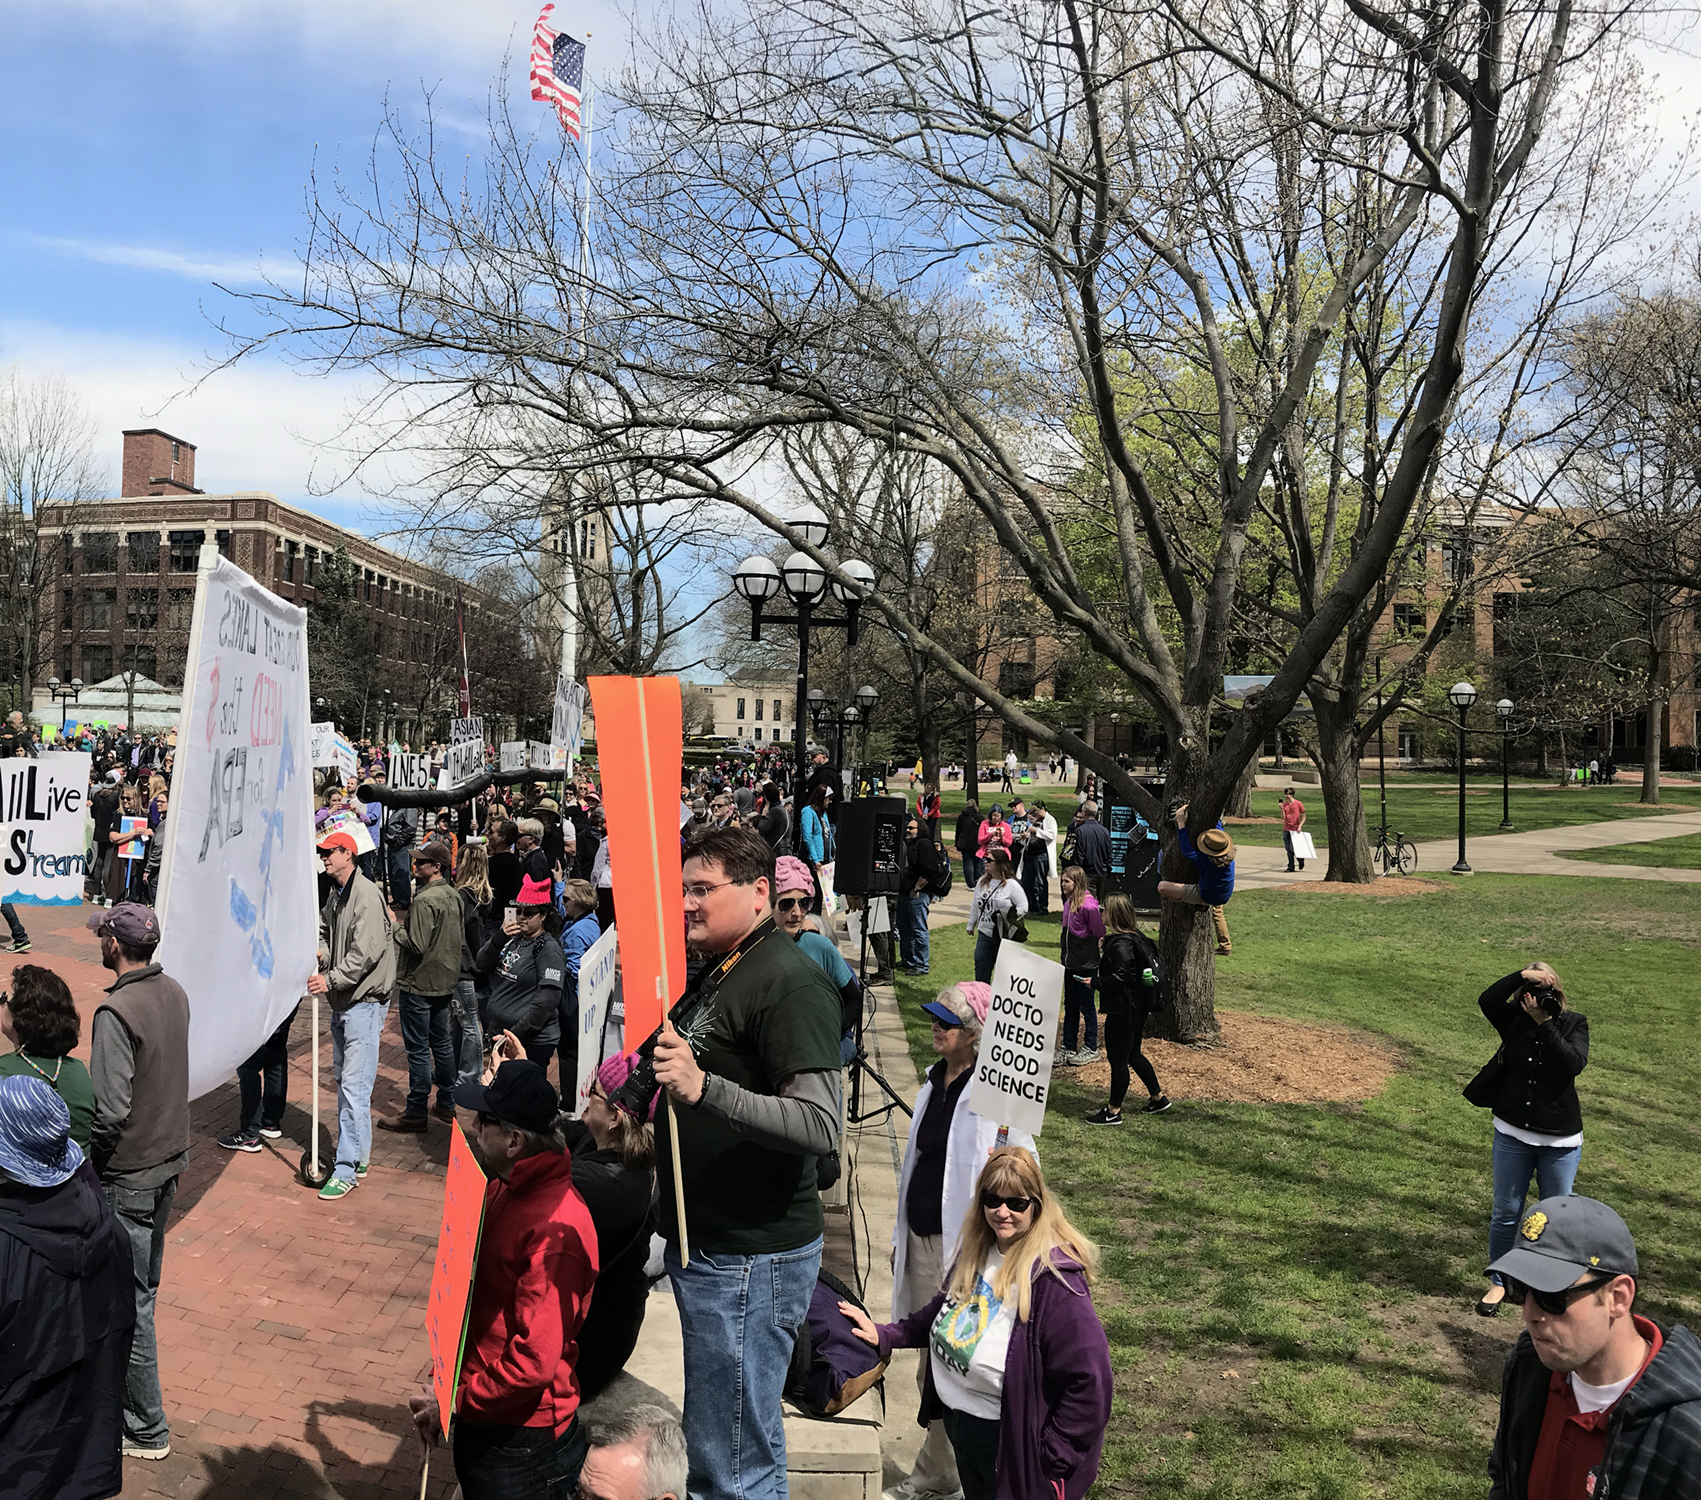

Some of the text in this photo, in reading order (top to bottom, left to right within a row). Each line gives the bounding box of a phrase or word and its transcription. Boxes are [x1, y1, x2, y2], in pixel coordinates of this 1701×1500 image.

[315, 725, 330, 733] OUR
[453, 717, 483, 737] ASIAN
[417, 754, 428, 789] 5
[24, 765, 82, 821] Live
[329, 811, 356, 824] TRUST
[589, 947, 615, 997] STAND
[721, 951, 742, 973] Nikon
[584, 1003, 597, 1035] UP
[991, 994, 1044, 1027] DOCTO
[993, 1019, 1045, 1052] NEEDS
[990, 1044, 1039, 1076] GOOD
[978, 1065, 1046, 1104] SCIENCE
